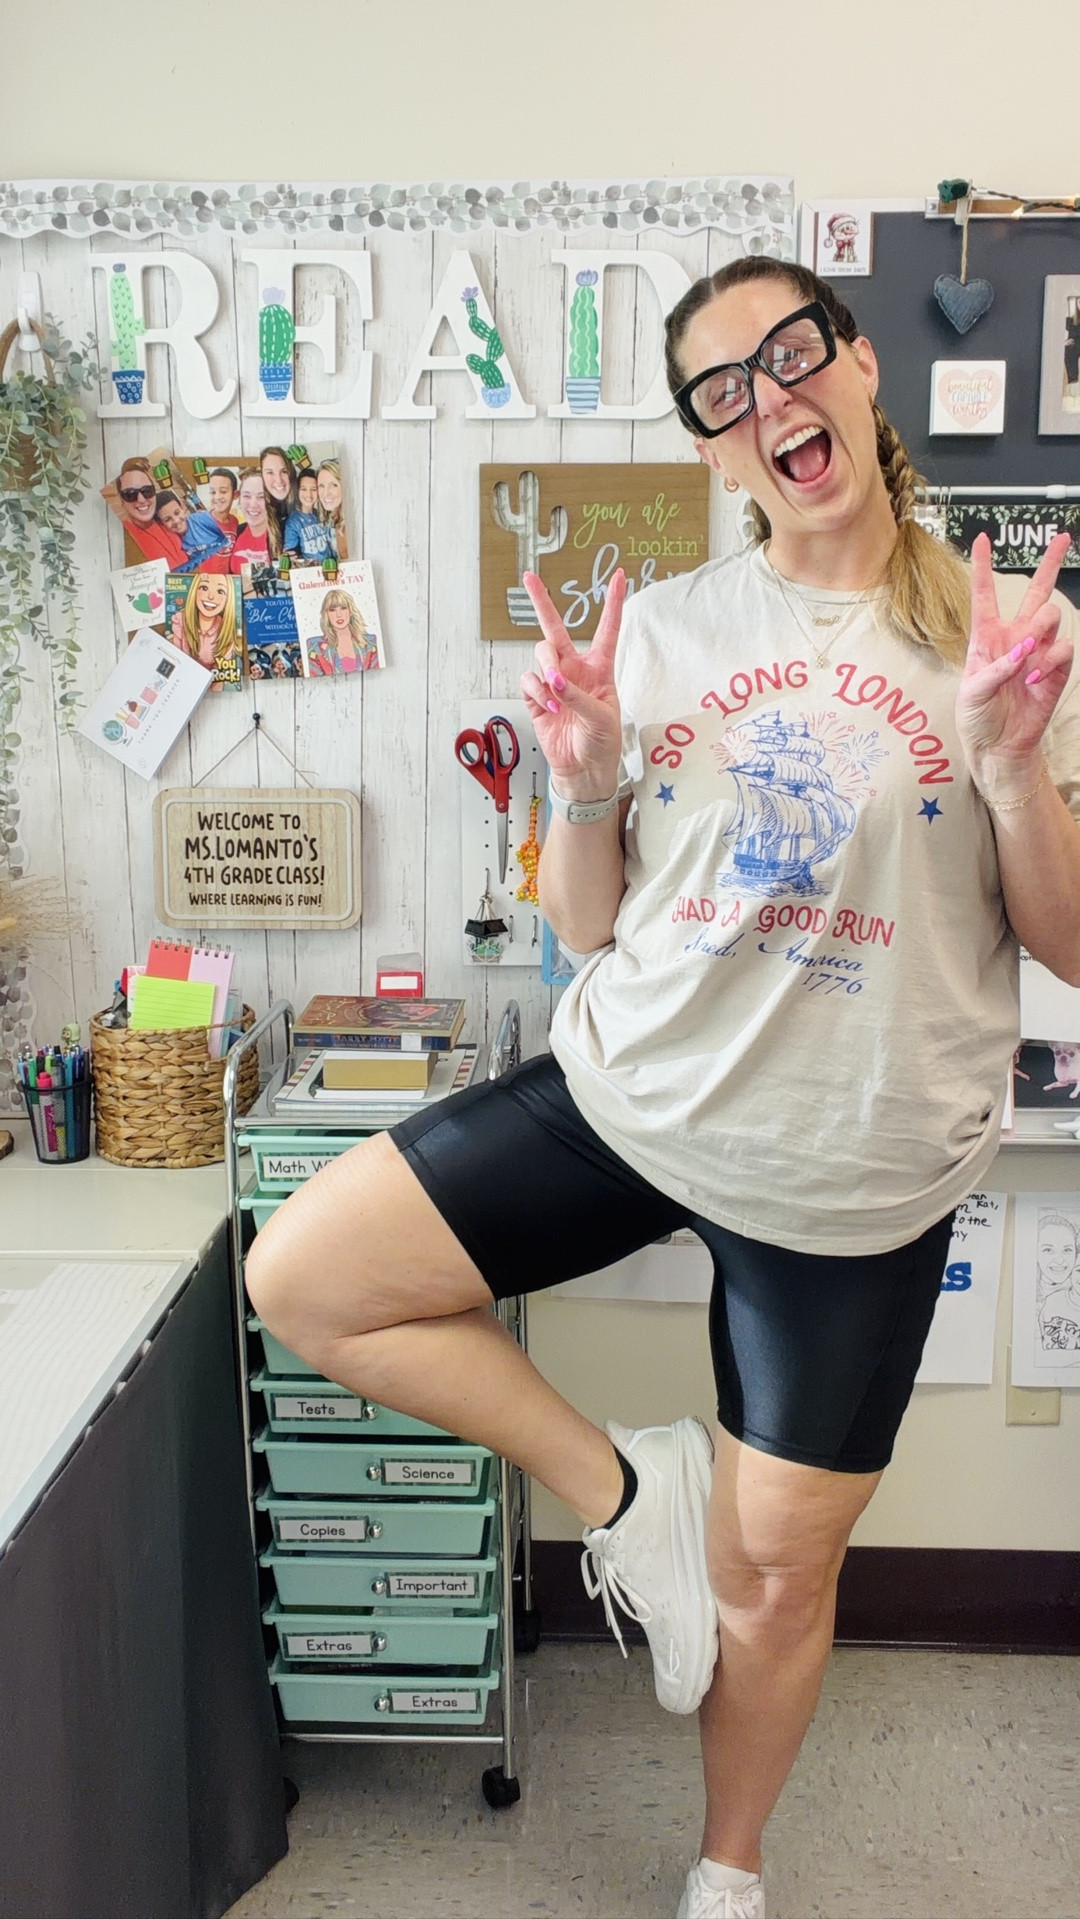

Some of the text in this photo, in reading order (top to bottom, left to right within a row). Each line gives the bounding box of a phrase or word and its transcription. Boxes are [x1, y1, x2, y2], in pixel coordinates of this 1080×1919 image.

[89, 248, 692, 420] READ
[952, 391, 988, 404] CAPABLE
[952, 402, 988, 420] worthy
[574, 493, 681, 549] you are
[993, 523, 1058, 547] JUNE
[627, 535, 704, 556] lookin'
[248, 608, 275, 624] Blue
[215, 657, 236, 670] You
[212, 669, 241, 682] Rock!
[650, 660, 954, 786] SO LONG LONDON
[198, 811, 302, 832] WELCOME TO
[184, 865, 326, 886] 4TH GRADE CLASS!
[189, 892, 228, 906] WHERE
[298, 893, 322, 908] FUN!
[672, 895, 895, 949] HAD A GOOD RUN
[758, 934, 864, 972] America
[801, 972, 870, 996] 1776
[269, 1160, 306, 1174] Math
[968, 1216, 992, 1227] the
[296, 1401, 336, 1416] Tests
[402, 1466, 455, 1480] Science
[300, 1524, 346, 1538] Copies
[396, 1578, 468, 1593] Important
[306, 1639, 353, 1652] Extras
[412, 1696, 458, 1708] Extras
